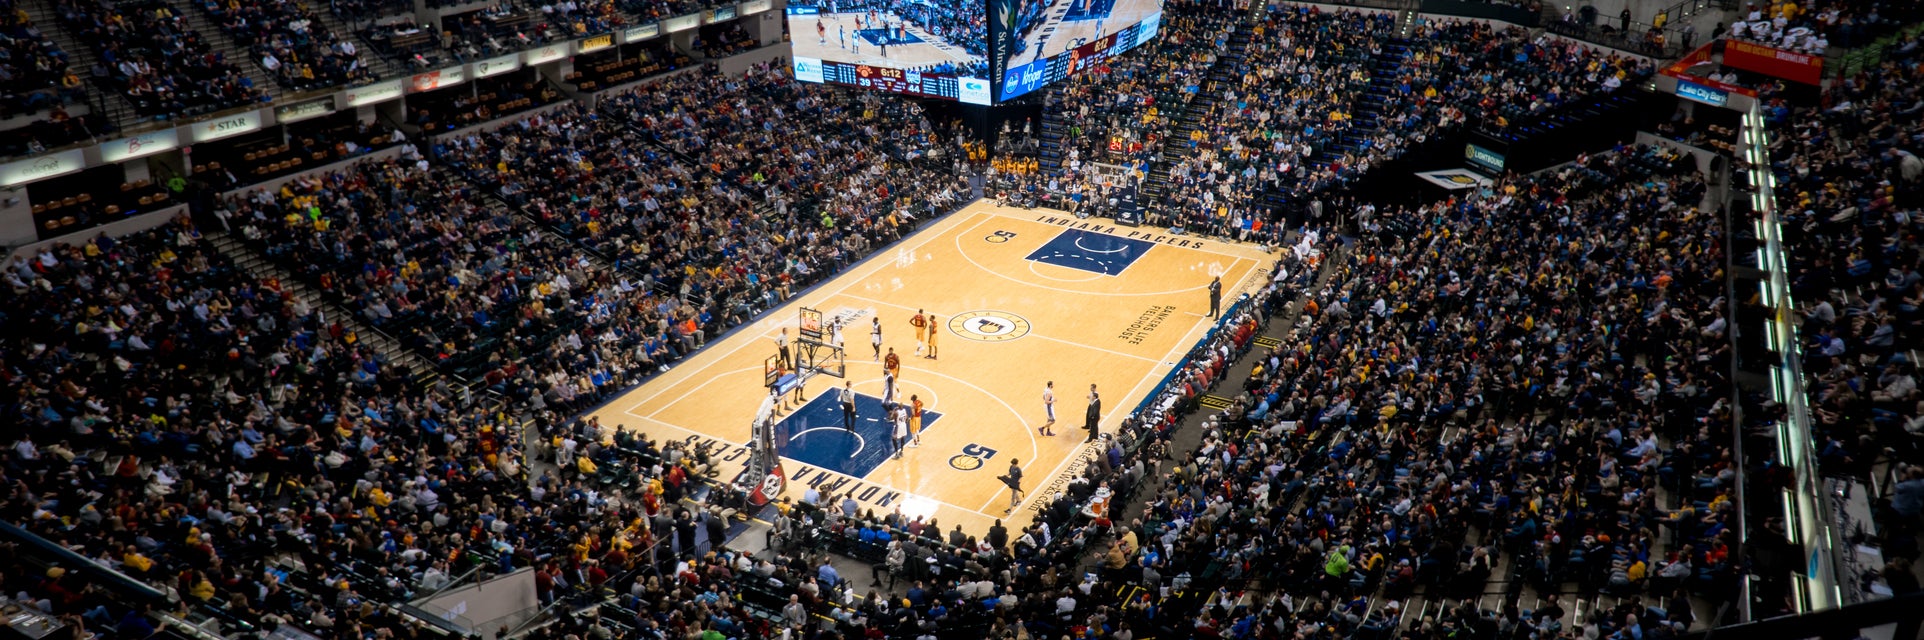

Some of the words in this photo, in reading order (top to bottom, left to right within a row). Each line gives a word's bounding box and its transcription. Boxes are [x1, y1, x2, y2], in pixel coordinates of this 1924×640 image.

[998, 32, 1007, 45] St.
[996, 45, 1006, 84] Vincent
[1776, 51, 1810, 65] DRUMLINE
[880, 68, 901, 78] 6:12
[1022, 63, 1043, 91] Kroger
[859, 78, 871, 87] 39
[908, 85, 920, 94] 44
[1697, 88, 1711, 101] City
[1710, 92, 1728, 103] Bank
[217, 117, 246, 131] STAR
[1110, 141, 1122, 150] 24
[1474, 149, 1504, 168] LIGHTBOUND
[1037, 215, 1117, 235] INDIANA
[1128, 230, 1205, 250] PACERS
[1118, 305, 1162, 340] FIELDHOUSE
[1143, 305, 1177, 332] BANKERS
[1129, 332, 1148, 346] LIFE
[791, 465, 902, 508] NDIANA
